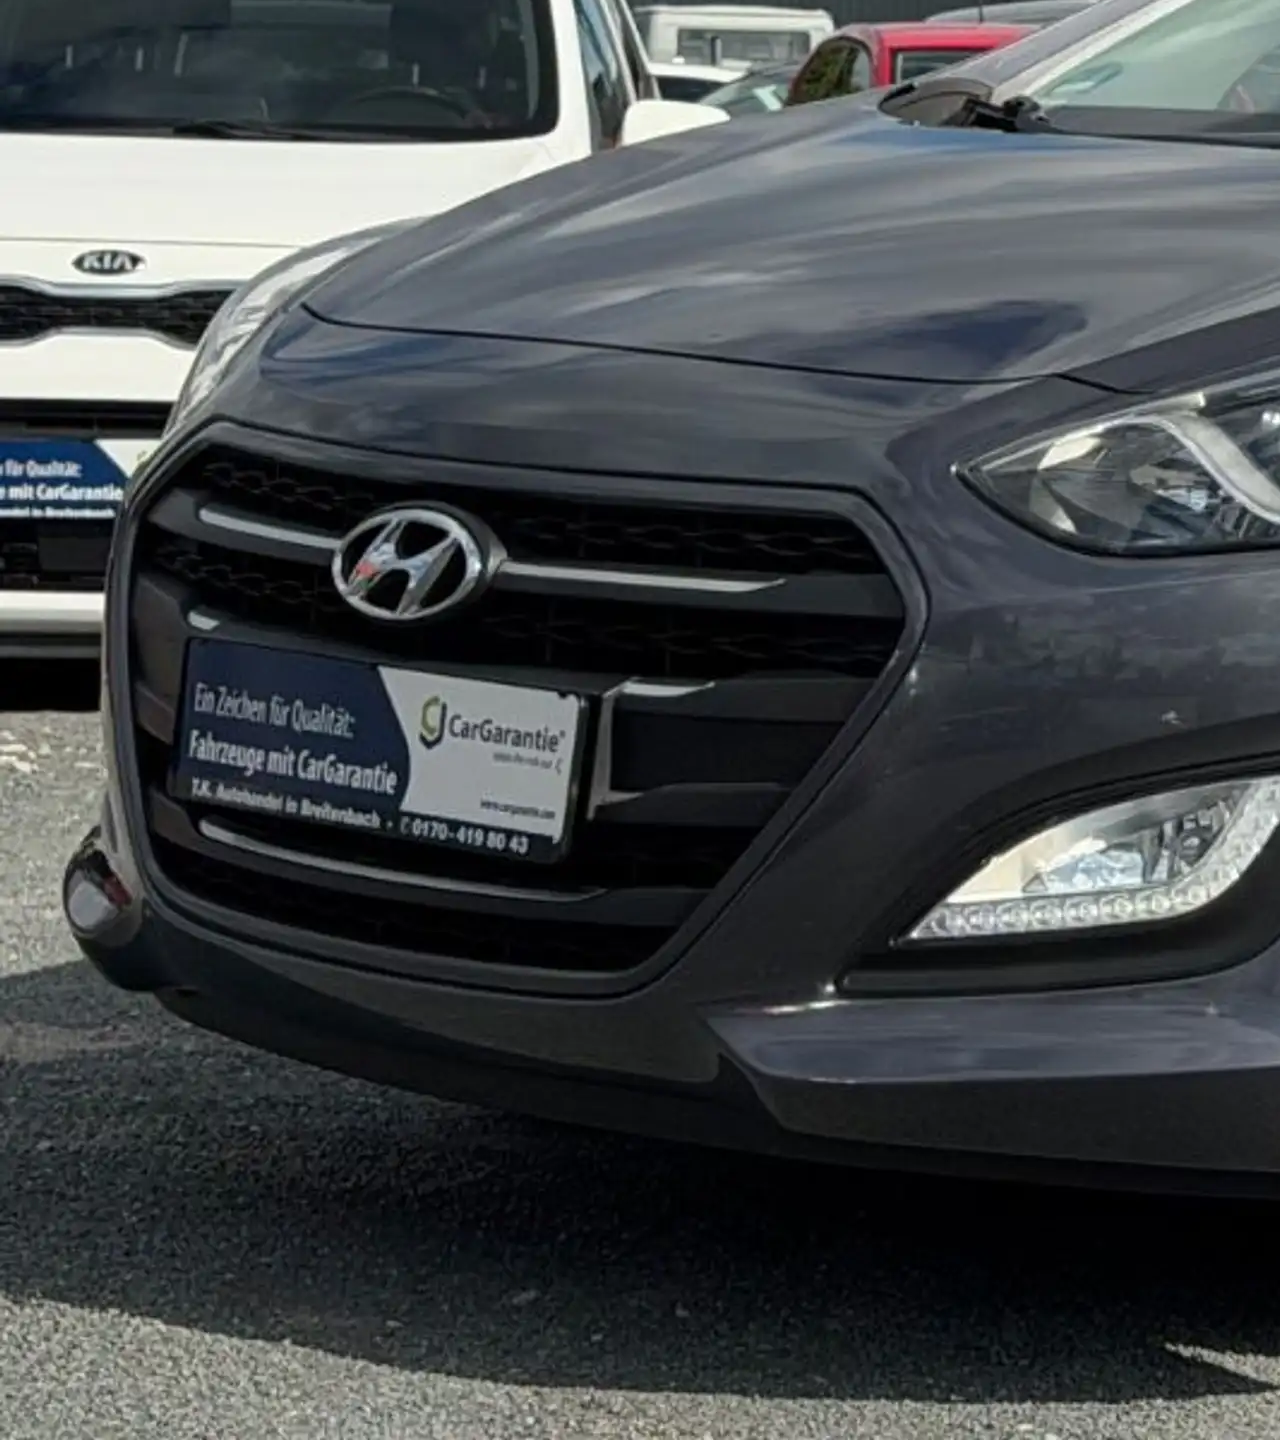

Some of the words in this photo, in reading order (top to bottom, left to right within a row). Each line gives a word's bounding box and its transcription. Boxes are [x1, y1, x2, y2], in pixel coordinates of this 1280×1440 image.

[82, 252, 133, 270] KIA
[194, 681, 215, 713] Ein
[215, 685, 267, 724] Zeichen
[268, 694, 290, 727] für
[291, 698, 356, 739] Qualität:
[188, 728, 266, 777] Fahrzeuge
[266, 744, 297, 777] mit
[297, 748, 398, 795] CarGarantie
